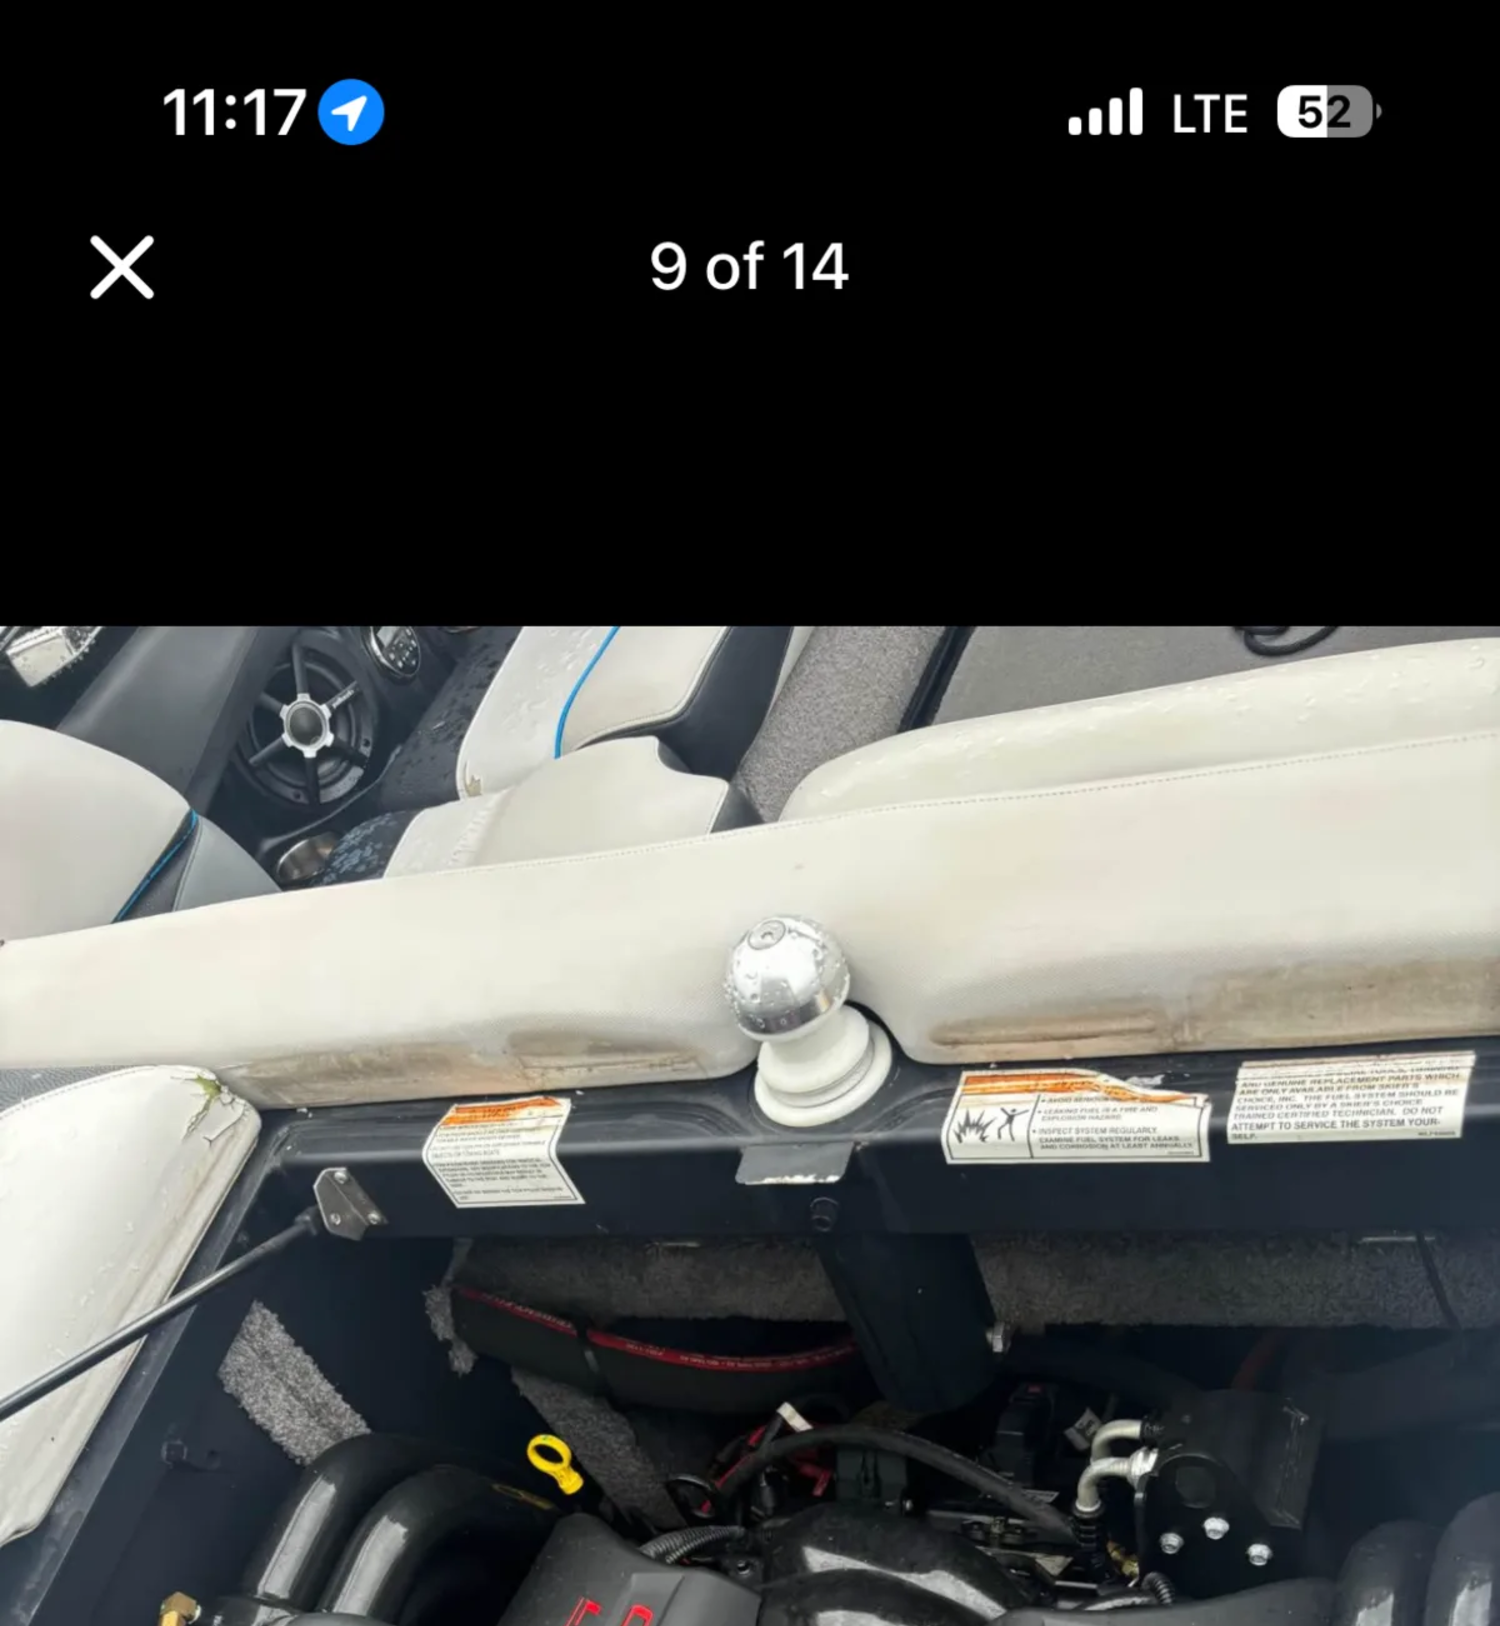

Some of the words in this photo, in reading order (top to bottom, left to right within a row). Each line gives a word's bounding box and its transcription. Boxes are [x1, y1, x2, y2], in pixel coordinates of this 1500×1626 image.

[1310, 1076, 1386, 1085] REPLACEMENT
[1424, 1072, 1461, 1080] WHICH
[1260, 1087, 1288, 1095] ONLY
[1289, 1086, 1344, 1094] AVAILABLE
[1354, 1091, 1396, 1099] SYSTEM
[1382, 1099, 1424, 1107] CHOICE
[1233, 1112, 1276, 1120] TRAINED
[1277, 1110, 1331, 1119] CERTIFIED
[1332, 1108, 1397, 1118] TECHNICIAN.
[1402, 1107, 1419, 1115] DO
[1420, 1106, 1444, 1115] NOT
[1231, 1121, 1276, 1131] ATTEMPT
[1279, 1121, 1292, 1130] TO
[1293, 1120, 1338, 1129] SERVICE
[1340, 1119, 1361, 1129] THE
[1362, 1118, 1406, 1128] SYSTEM
[1406, 1117, 1441, 1127] YOUR-
[1038, 1127, 1073, 1135] INSPECT
